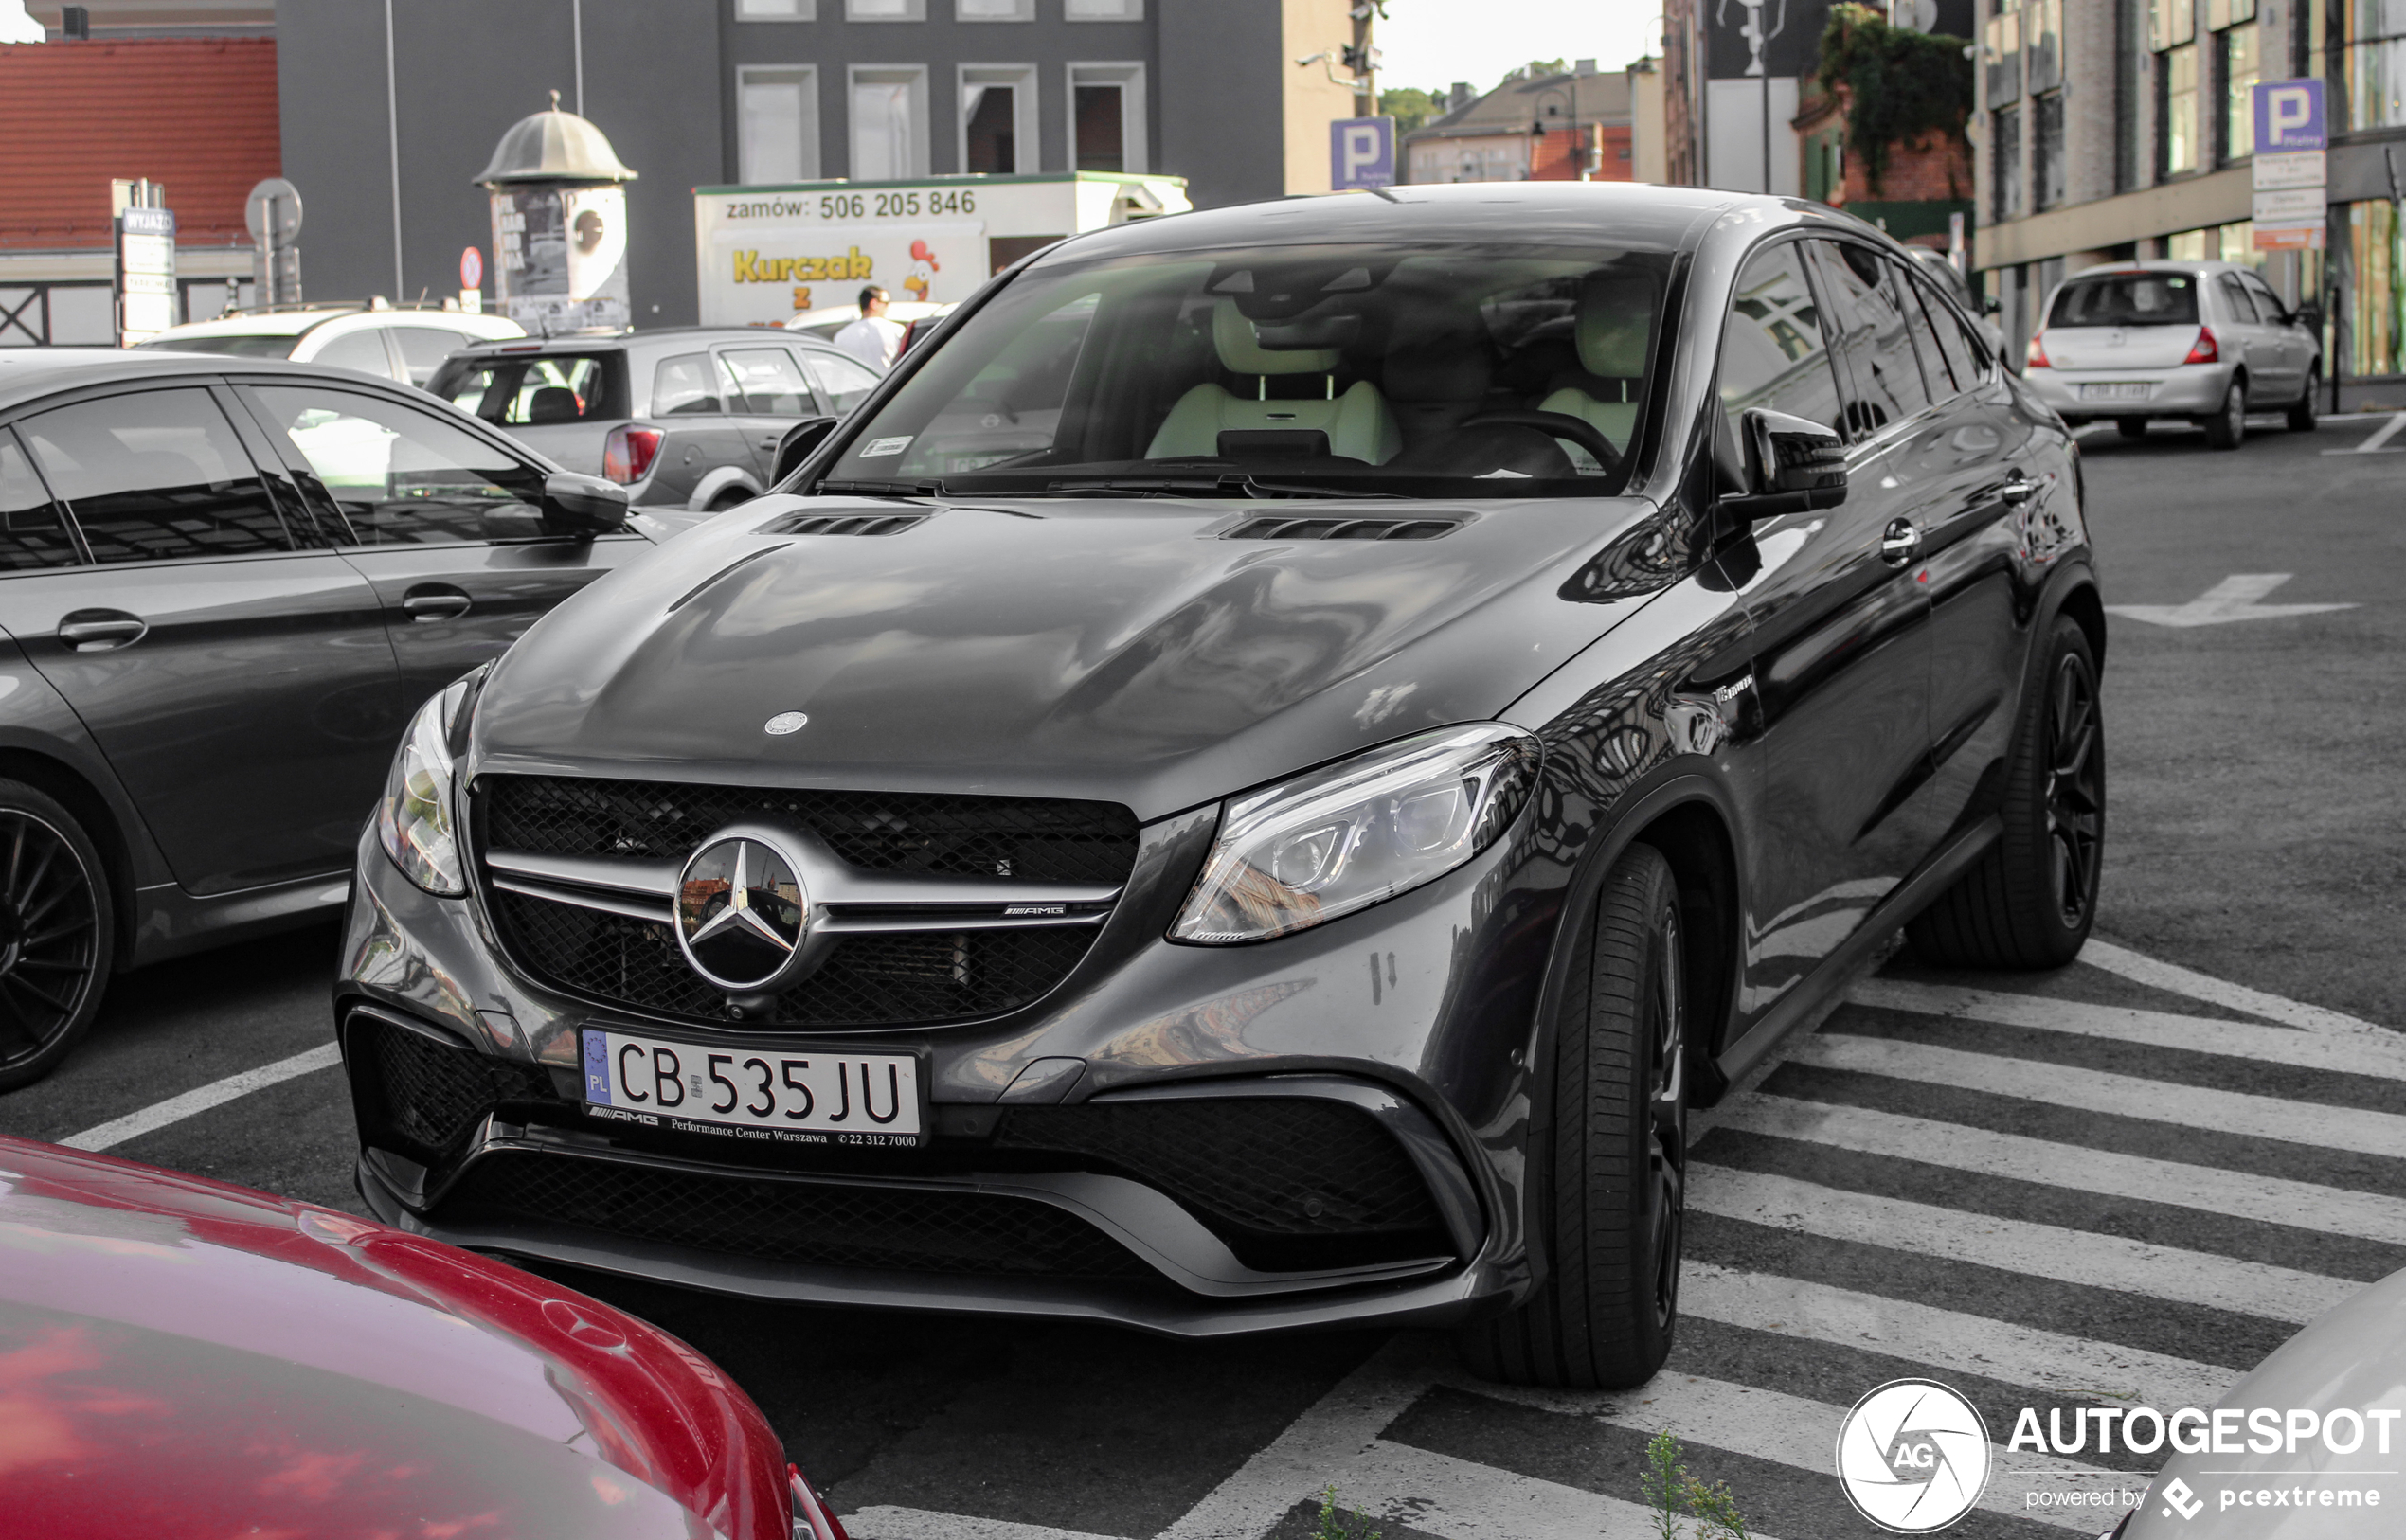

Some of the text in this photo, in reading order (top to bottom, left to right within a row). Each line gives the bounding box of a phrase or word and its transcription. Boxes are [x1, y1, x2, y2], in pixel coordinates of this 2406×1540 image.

[2268, 87, 2310, 146] P
[1344, 125, 1380, 181] P
[127, 212, 173, 231] WYJAZD
[727, 191, 976, 219] zamów: 506 205 846
[733, 246, 872, 282] Kurczak
[793, 287, 811, 309] z
[590, 1075, 608, 1093] PL
[619, 1042, 685, 1108] CB
[609, 1110, 916, 1147] AMG Performance Center Warszawa 22 312 7000
